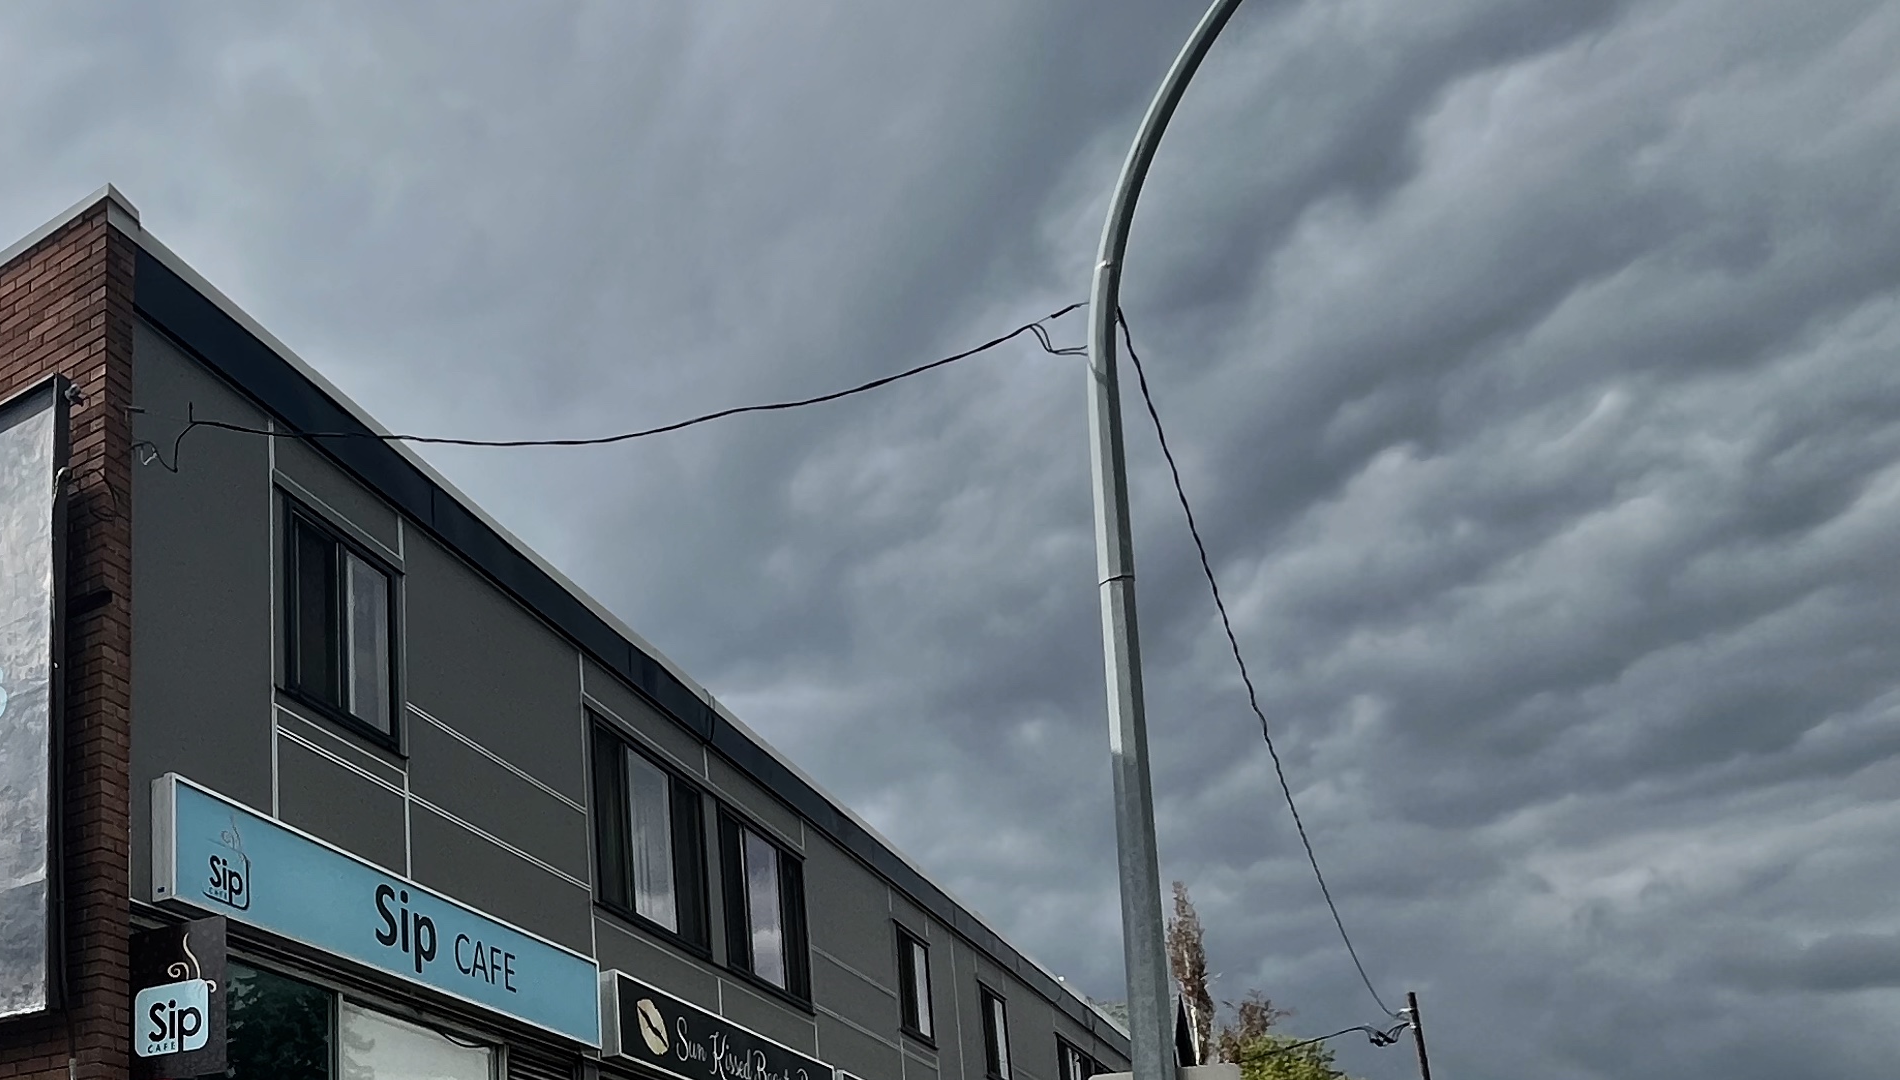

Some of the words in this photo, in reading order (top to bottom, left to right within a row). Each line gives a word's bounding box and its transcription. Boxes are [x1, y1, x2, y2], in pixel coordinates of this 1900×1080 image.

[208, 854, 243, 904] Sip
[374, 883, 438, 974] Sip
[453, 932, 518, 994] CAFE
[147, 1041, 176, 1054] CAFE
[148, 999, 202, 1053] Sip
[676, 1016, 708, 1062] Sun
